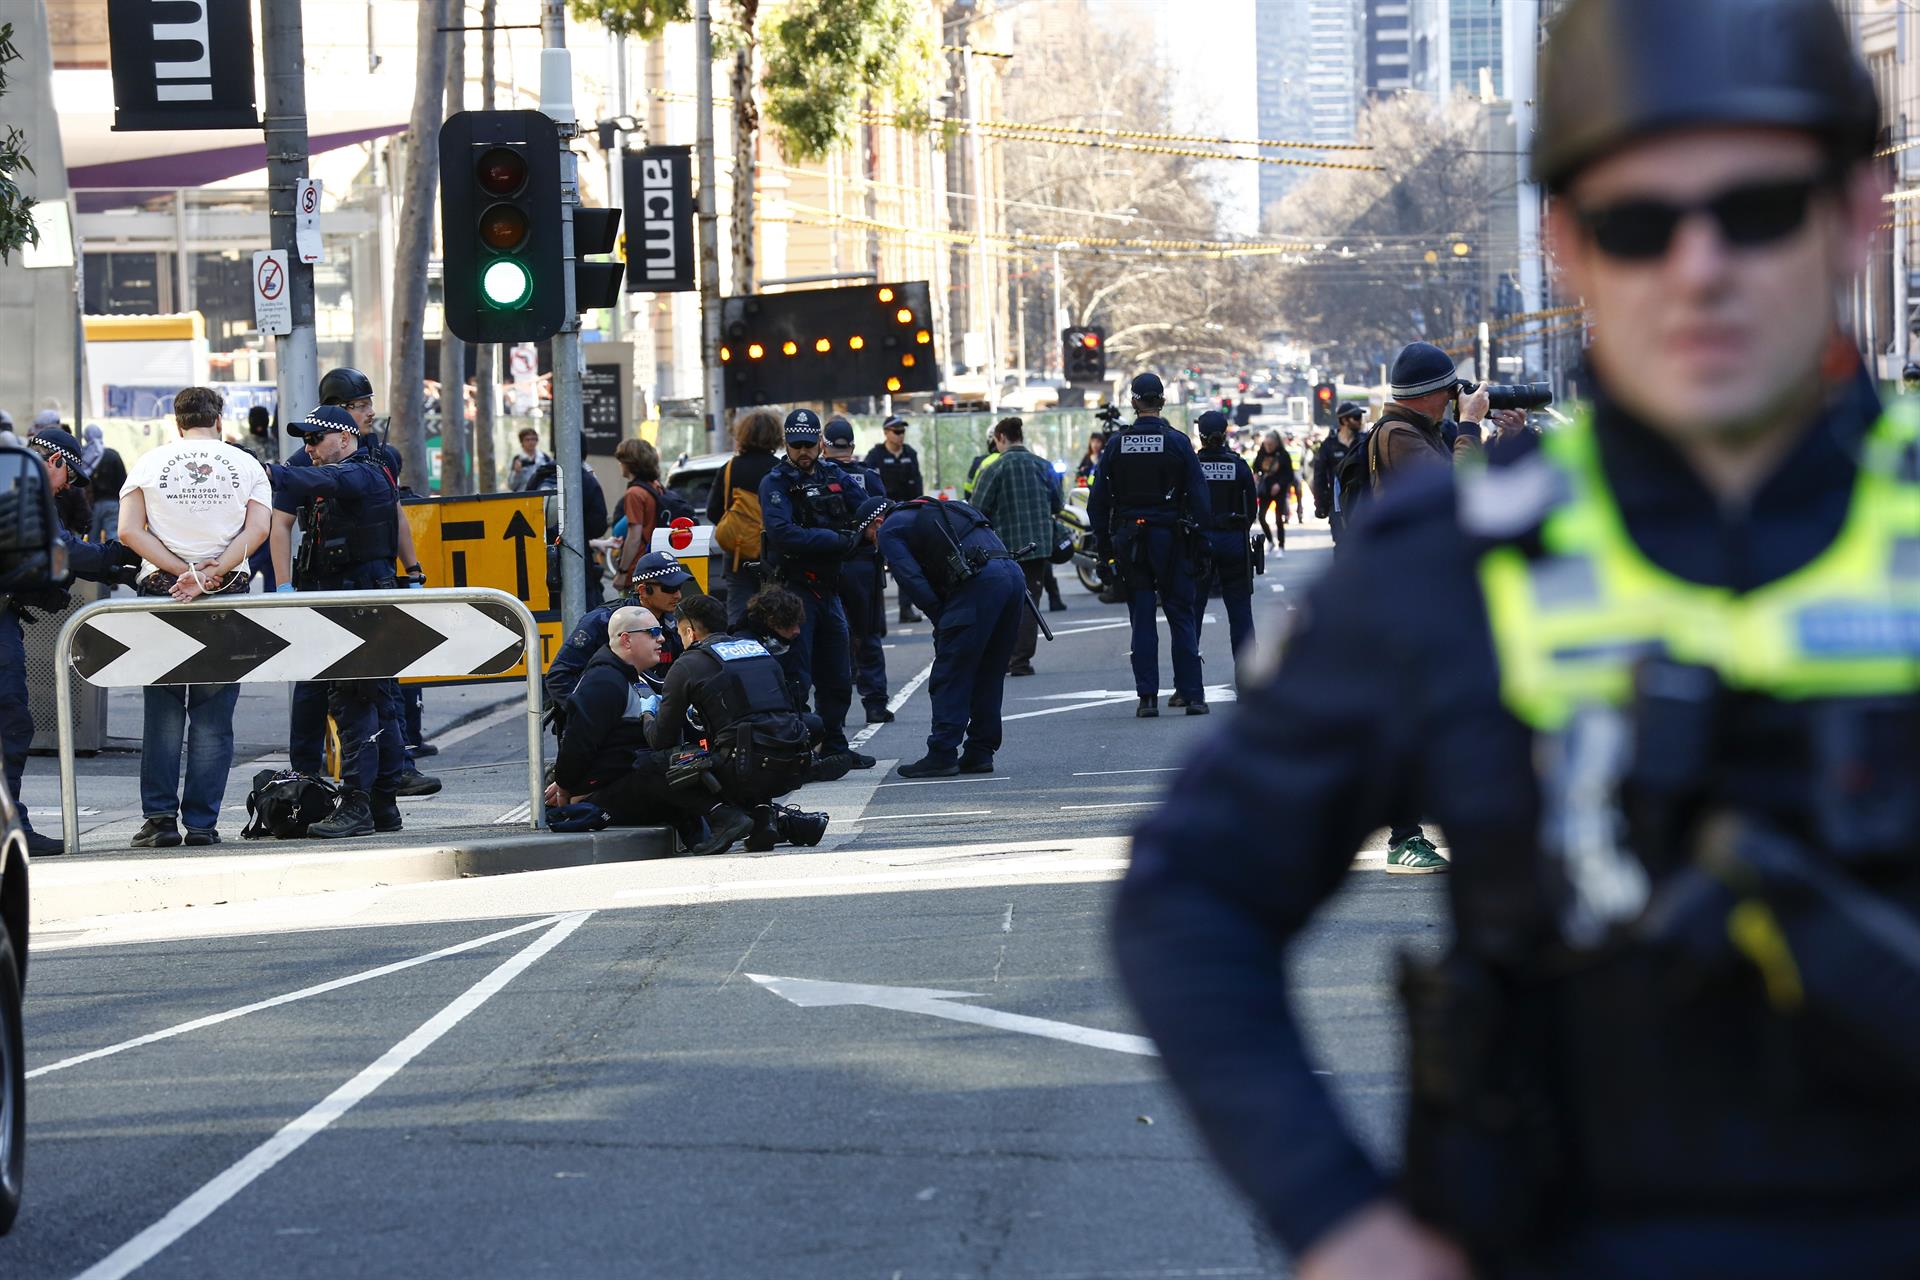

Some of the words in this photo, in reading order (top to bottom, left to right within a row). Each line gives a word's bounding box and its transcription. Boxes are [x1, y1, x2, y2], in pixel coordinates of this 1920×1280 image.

[642, 159, 676, 279] acmi
[160, 452, 208, 488] BROOKLYN
[214, 454, 240, 488] BOUND
[716, 644, 766, 658] Police
